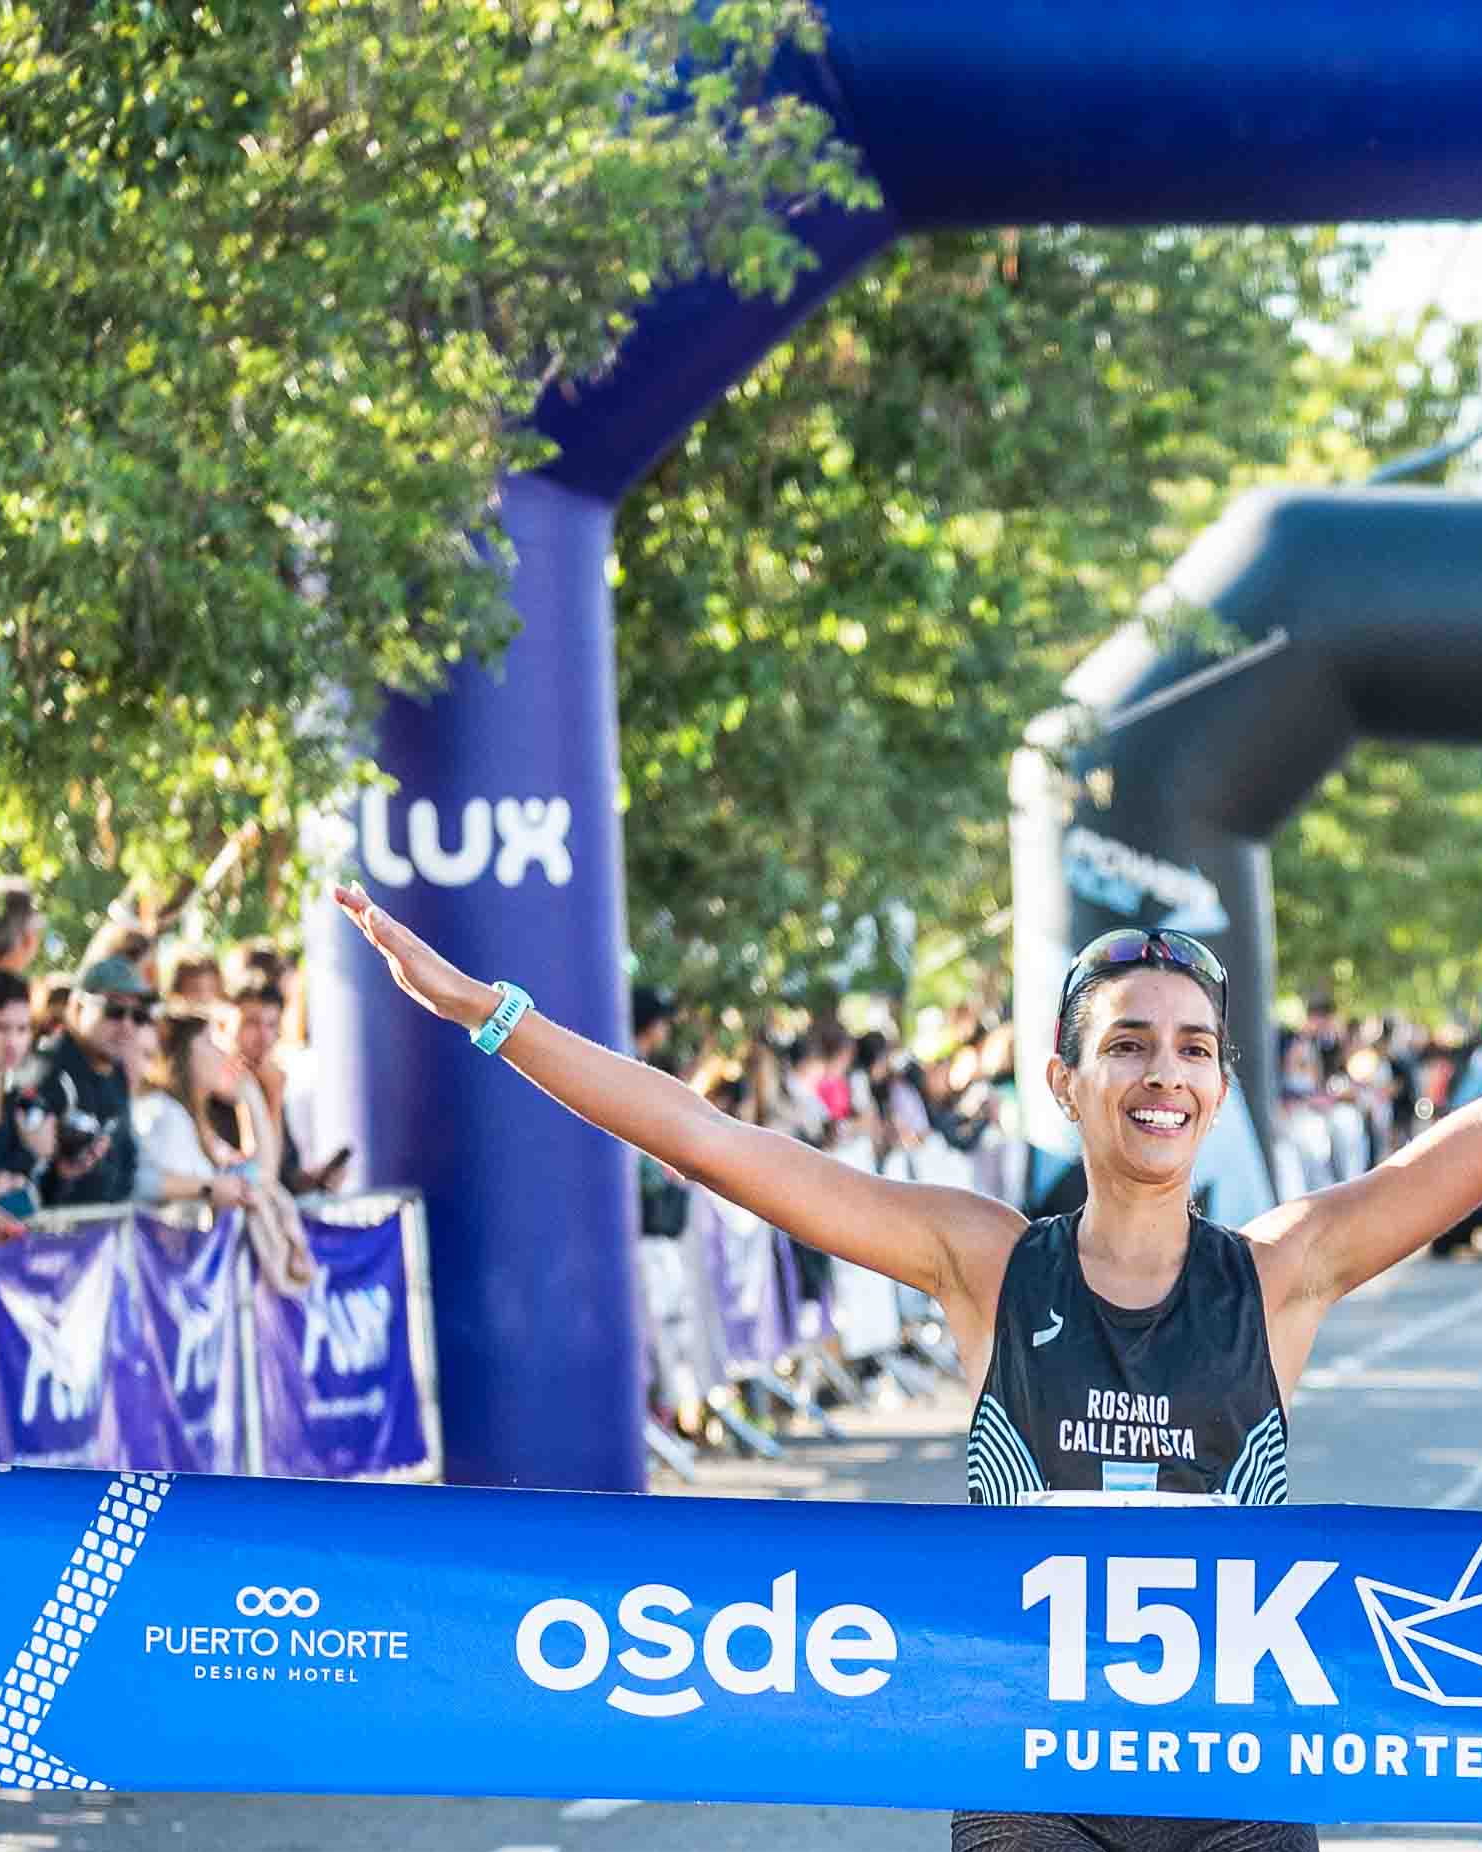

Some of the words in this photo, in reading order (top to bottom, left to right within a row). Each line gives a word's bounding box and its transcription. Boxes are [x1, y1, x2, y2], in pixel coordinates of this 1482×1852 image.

[1087, 1389, 1170, 1426] ROSARIO
[1059, 1420, 1196, 1460] CALLEYPISTA
[146, 1627, 278, 1655] PUERTO
[292, 1630, 407, 1658] NORTE
[516, 1570, 897, 1697] osde
[1023, 1556, 1338, 1705] 15K
[195, 1666, 275, 1680] DESIGN
[289, 1669, 357, 1681] HOTEL
[1025, 1729, 1260, 1773] PUERTO
